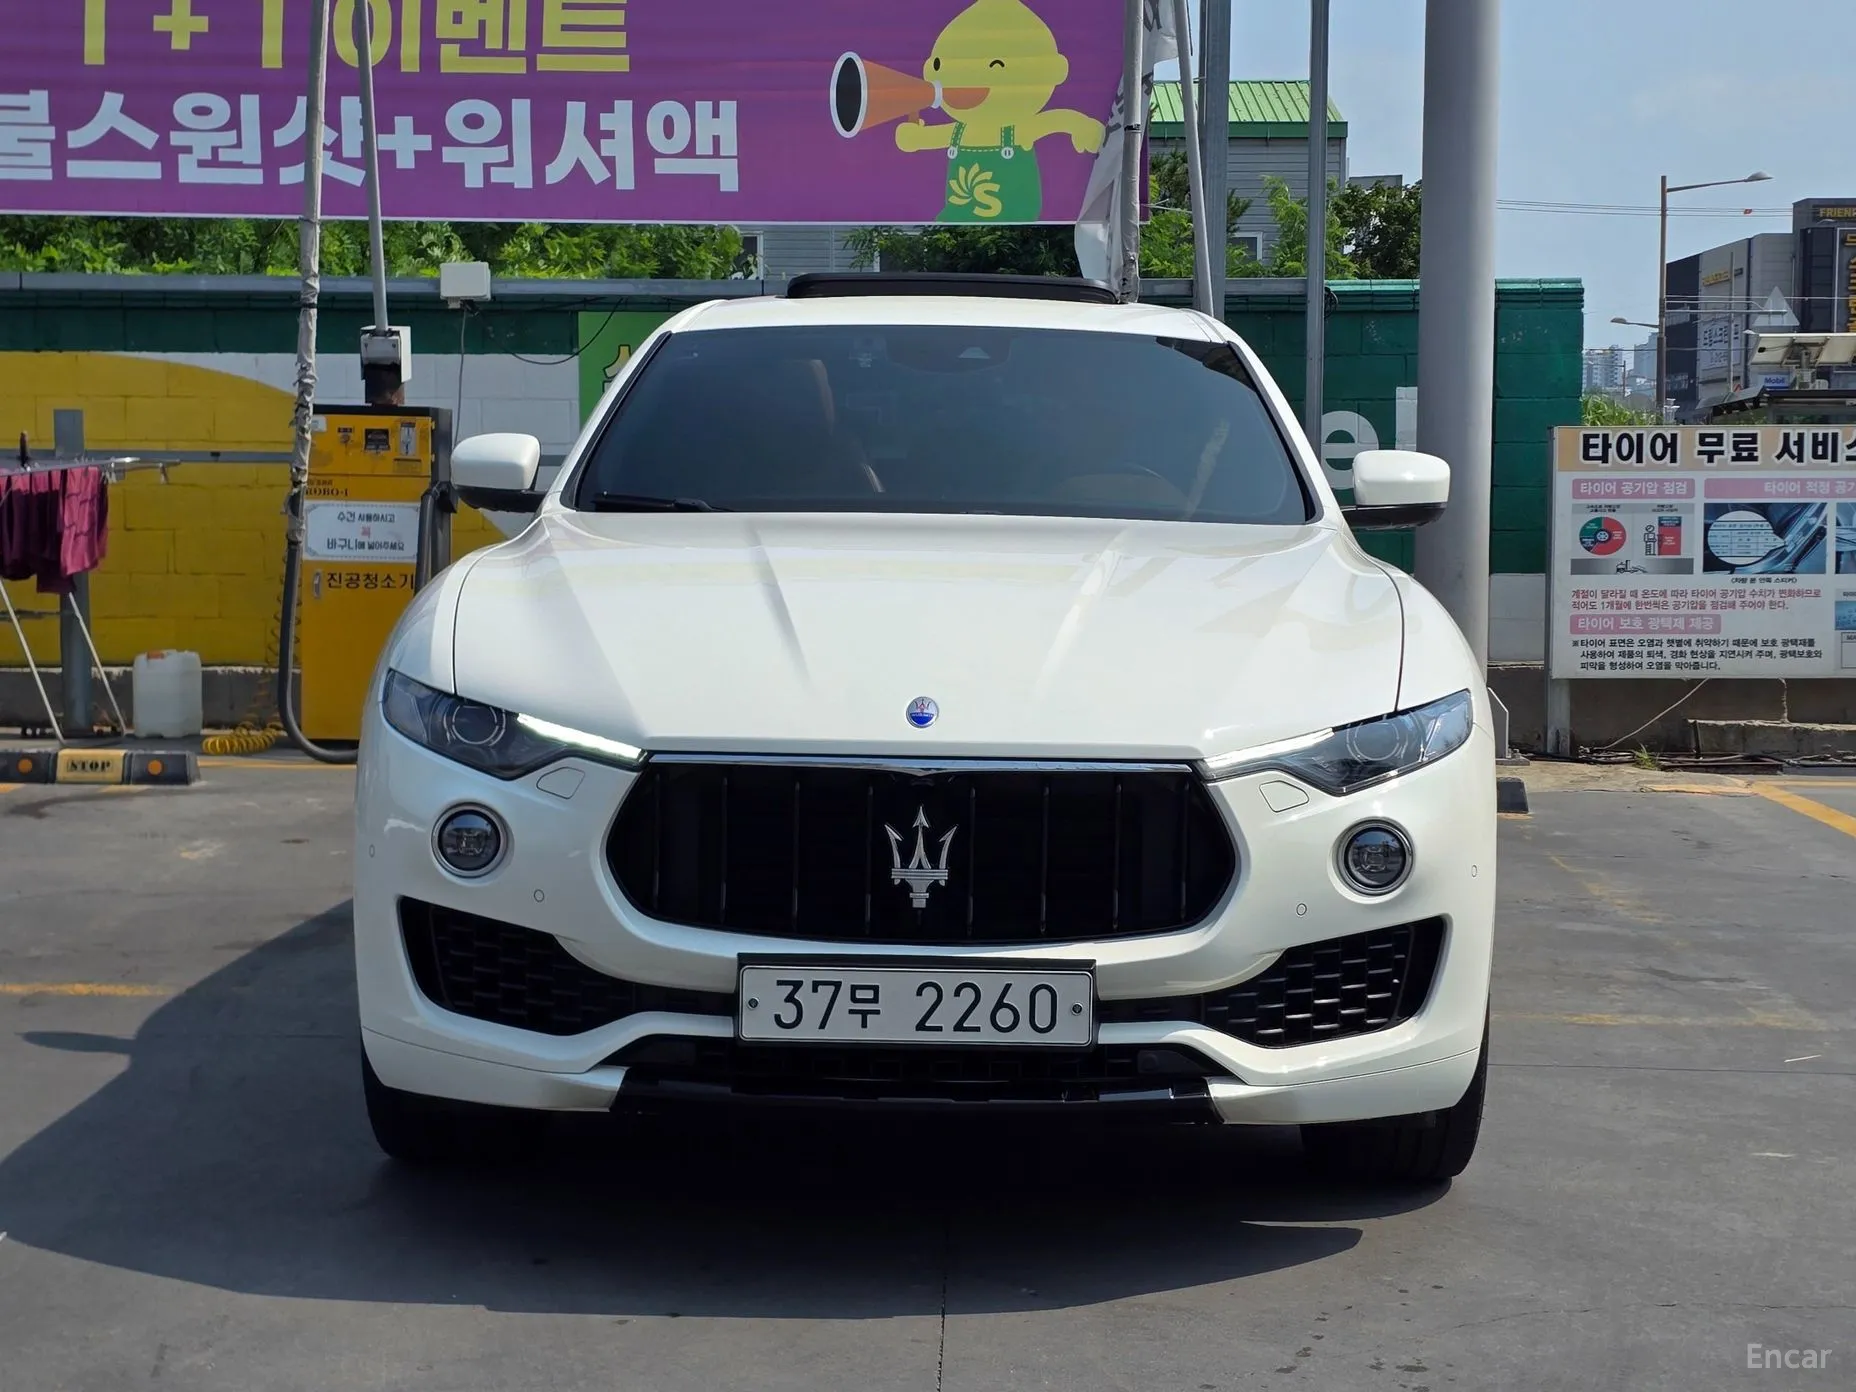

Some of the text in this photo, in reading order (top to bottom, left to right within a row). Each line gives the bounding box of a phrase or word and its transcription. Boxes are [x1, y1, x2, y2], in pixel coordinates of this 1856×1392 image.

[1581, 432, 1678, 464] 타이어
[1697, 432, 1759, 464] 무료
[1580, 481, 1688, 496] 타이어 공기압 점검
[1764, 480, 1800, 495] 타이어
[1806, 480, 1831, 495] 적정
[337, 511, 355, 524] 수건
[327, 538, 366, 551] 바구니에
[327, 572, 414, 590] 진공청소기
[1571, 589, 1821, 599] 계절이 달라질 때 온도에 따라 타이어 공기압 수치가 변화하므로
[1571, 600, 1597, 610] 적어도
[1601, 600, 1631, 610] 1개월에
[1635, 600, 1669, 610] 한번씩은
[1672, 600, 1706, 610] 공기압을
[1710, 600, 1736, 610] 점검해
[1739, 600, 1765, 610] 주어야
[1577, 617, 1614, 630] 타이어
[1619, 617, 1644, 630] 보호
[1609, 638, 1634, 648] 표면은
[1637, 638, 1663, 648] 오염과
[1695, 638, 1729, 648] 취약하기
[1732, 638, 1758, 648] 때문에
[1761, 638, 1778, 648] 보호
[1580, 649, 1615, 659] 사용하여
[1617, 649, 1643, 659] 제품의
[1670, 649, 1687, 659] 경화
[1690, 649, 1716, 659] 현상을
[1719, 649, 1753, 659] 지연시켜
[1580, 661, 1606, 671] 피막을
[1609, 661, 1643, 671] 형성하여
[69, 760, 111, 773] STOP
[773, 979, 1058, 1034] 37무 2260
